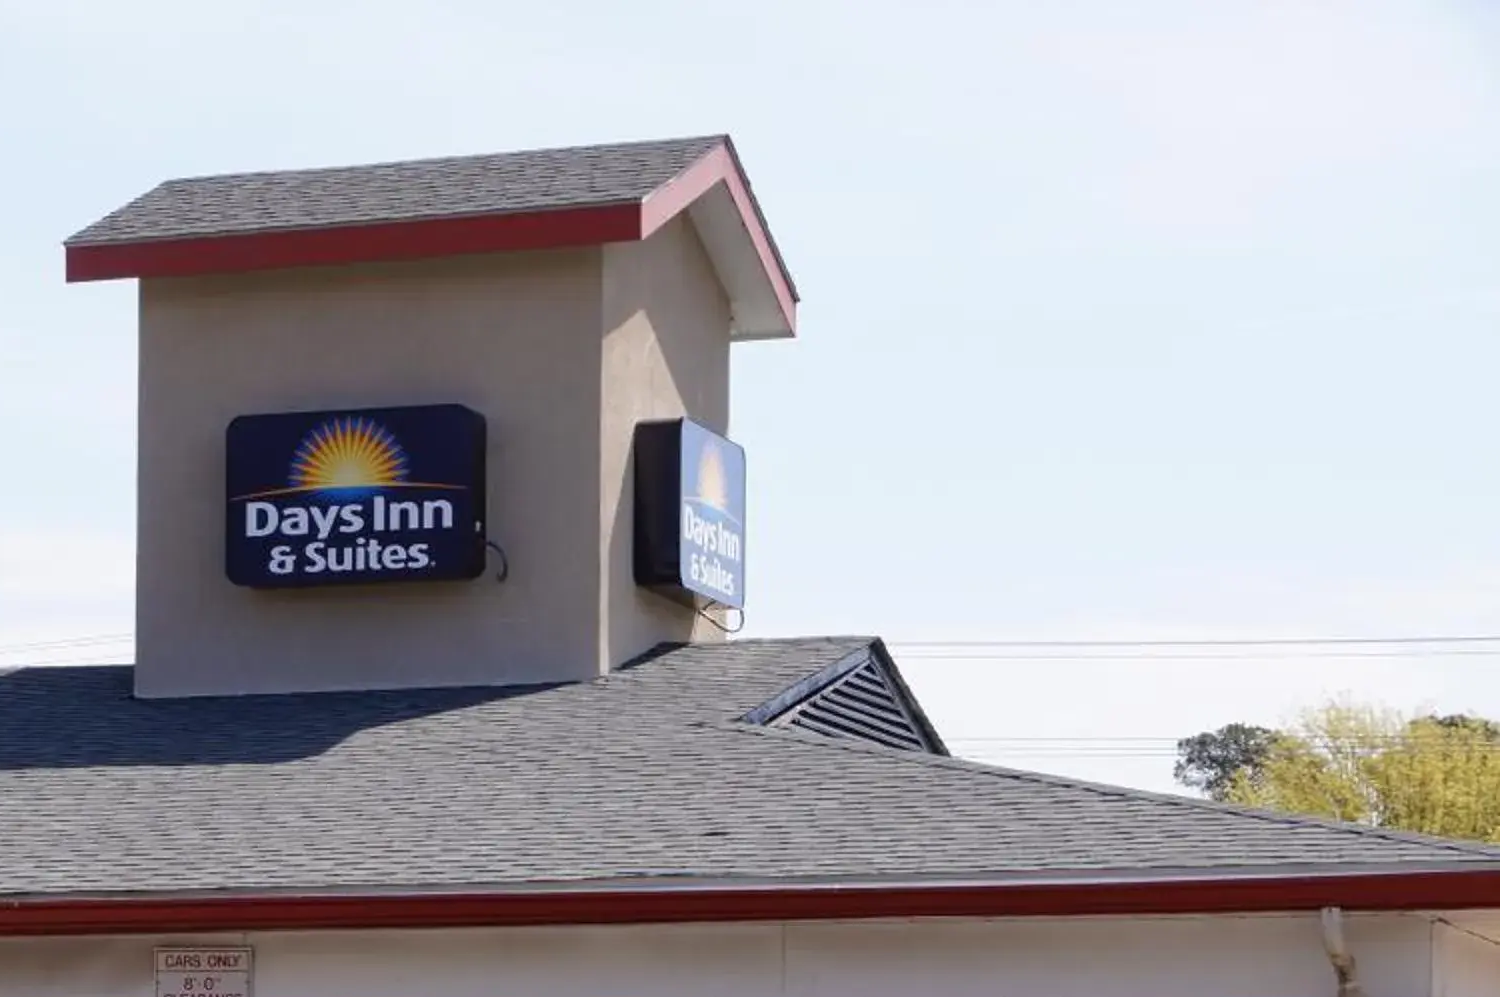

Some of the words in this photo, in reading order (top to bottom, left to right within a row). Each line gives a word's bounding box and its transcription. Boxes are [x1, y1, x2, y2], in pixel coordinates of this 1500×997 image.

[245, 501, 364, 539] Days
[373, 495, 453, 531] Inn
[684, 504, 717, 553] Days
[717, 520, 740, 561] Inn
[268, 545, 296, 574] &
[304, 537, 430, 573] Suites
[165, 954, 201, 968] CARS
[207, 954, 242, 968] ONLY
